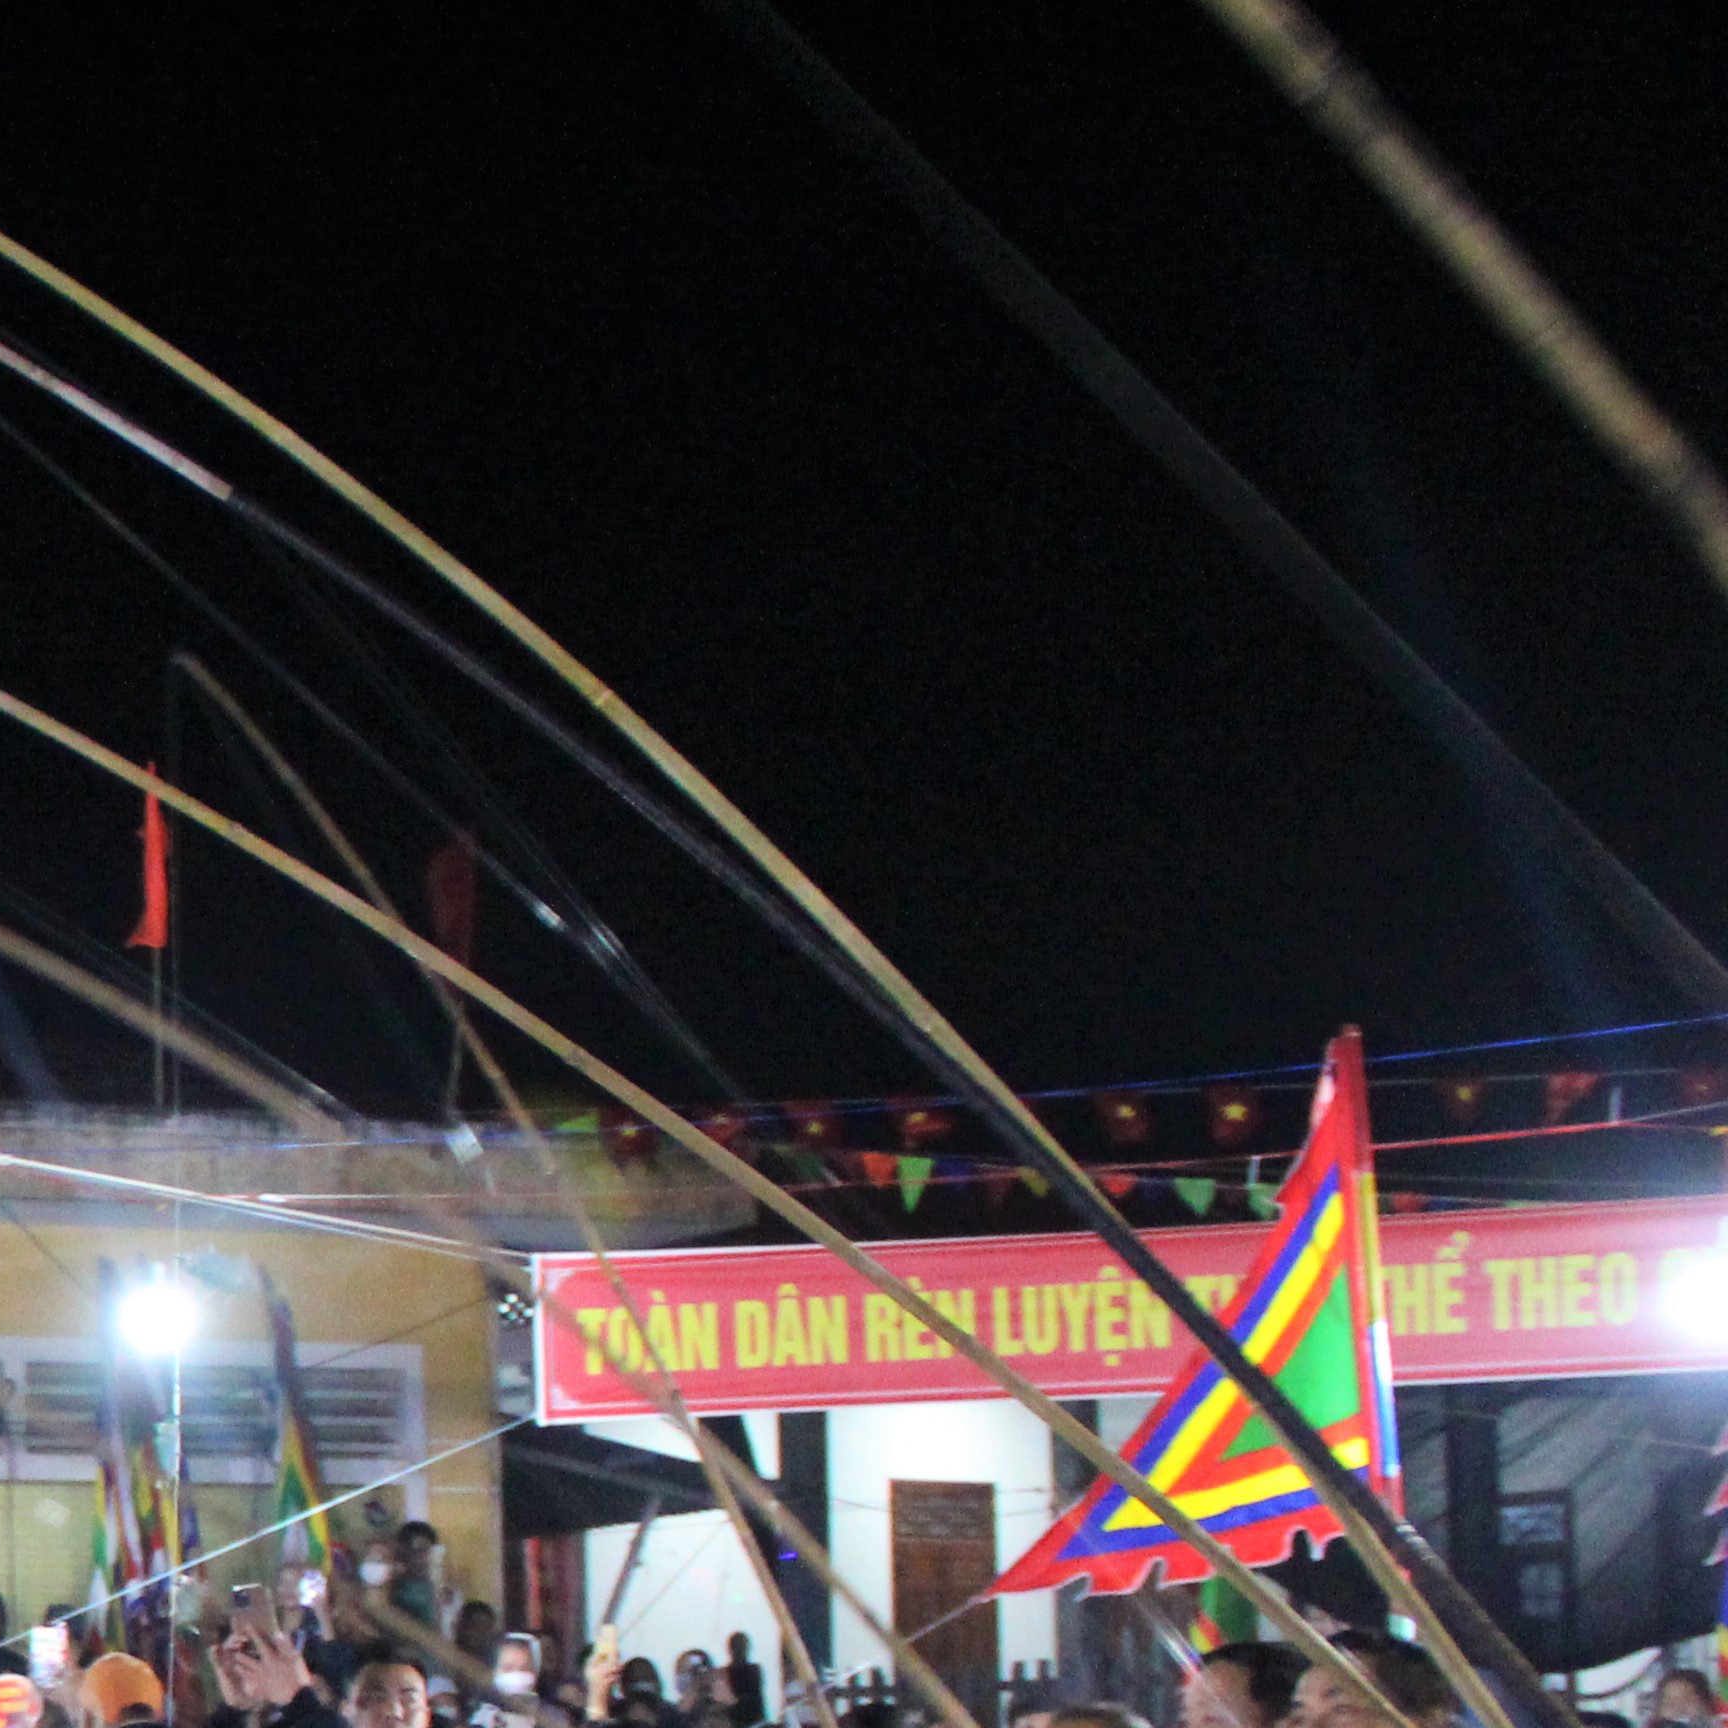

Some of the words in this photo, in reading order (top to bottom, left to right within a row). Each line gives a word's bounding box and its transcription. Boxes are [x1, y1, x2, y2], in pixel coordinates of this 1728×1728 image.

[575, 1289, 720, 1376] TOÀN
[734, 1282, 848, 1369] DÂN
[864, 1277, 977, 1363] RÈN
[992, 1265, 1173, 1366] LUYỆN
[1483, 1250, 1640, 1332] THEO
